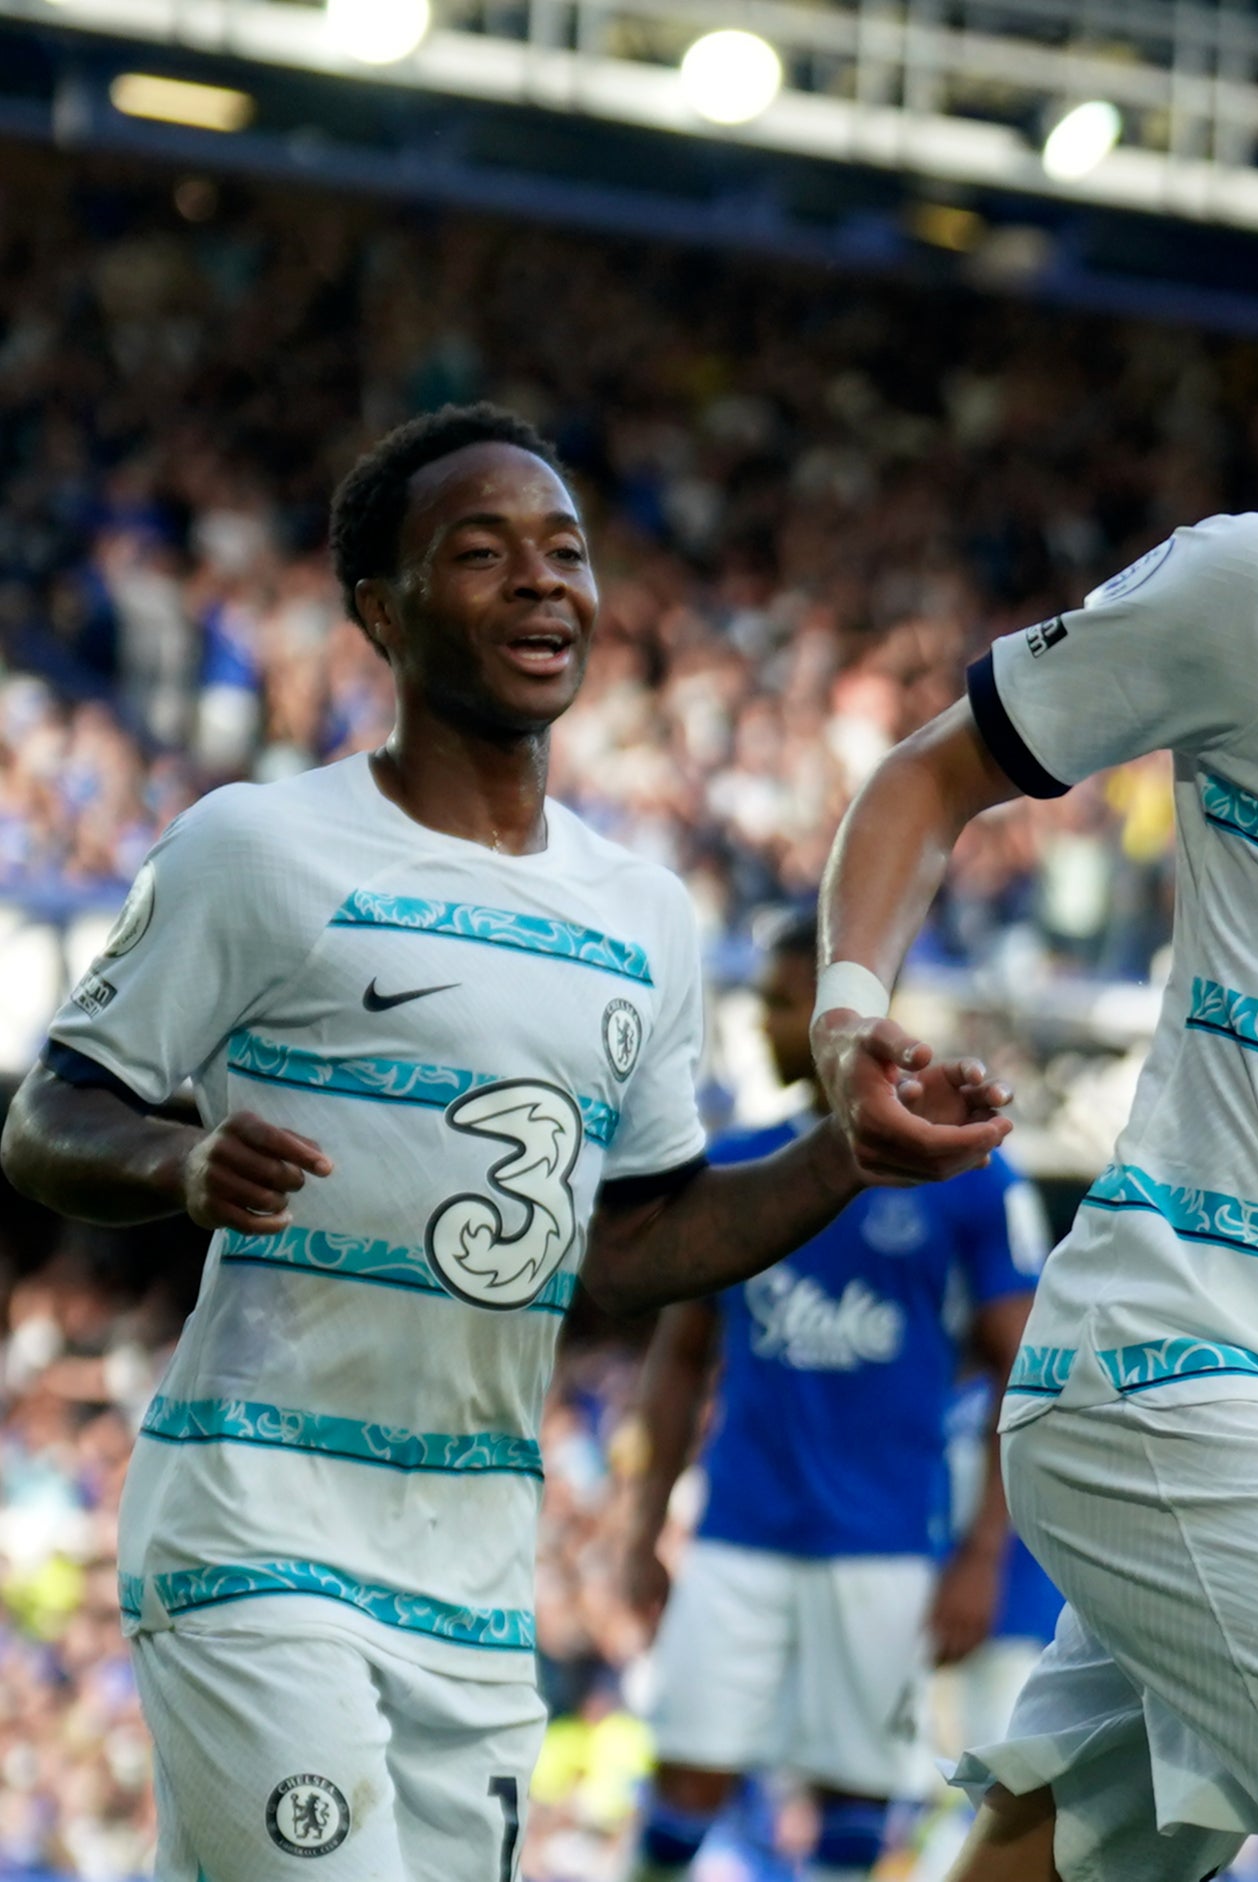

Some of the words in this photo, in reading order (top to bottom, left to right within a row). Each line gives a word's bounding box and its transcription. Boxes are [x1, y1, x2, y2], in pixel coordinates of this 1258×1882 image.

[424, 1078, 582, 1311] 3
[278, 1774, 335, 1794] CHELSEA
[487, 1775, 519, 1882] 1
